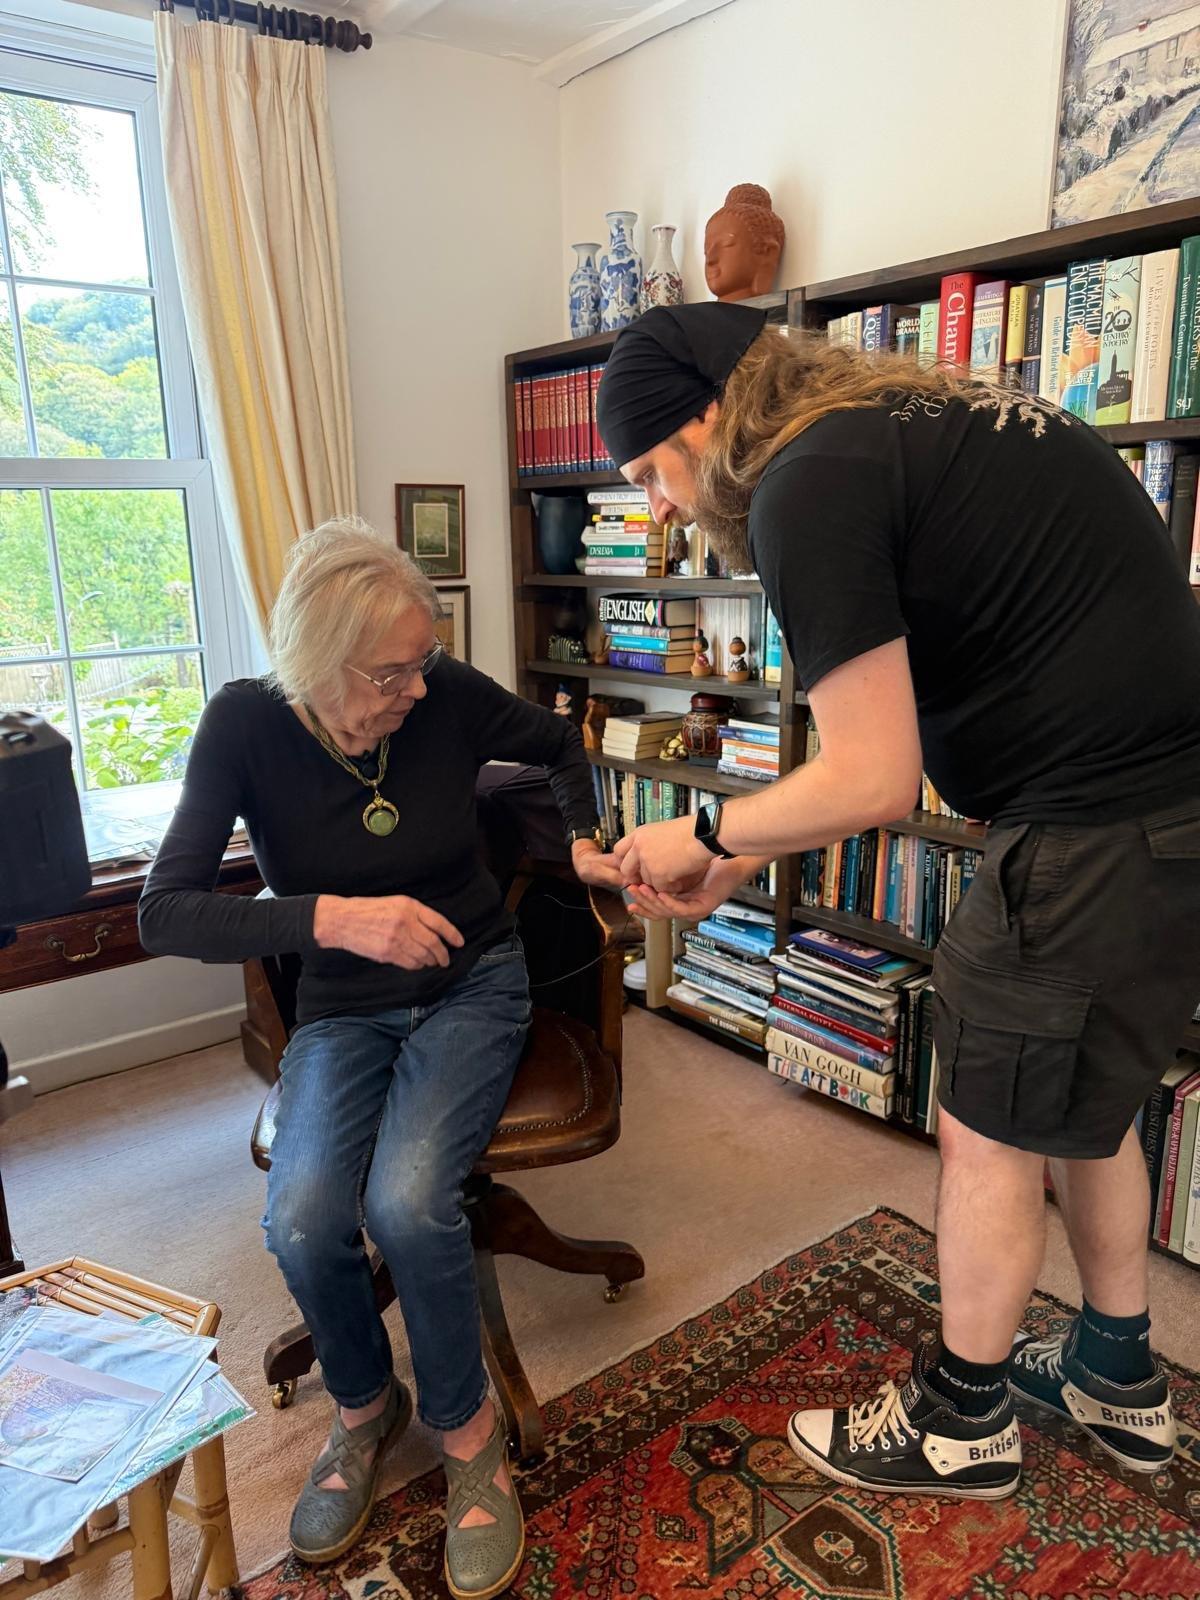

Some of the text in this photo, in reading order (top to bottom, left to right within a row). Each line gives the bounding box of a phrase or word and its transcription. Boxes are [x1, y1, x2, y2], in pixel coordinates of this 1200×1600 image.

[1154, 267, 1165, 300] LIVES
[1064, 264, 1089, 353] ENCYCLOPEDIA
[1083, 259, 1106, 348] THE MACMILLAN
[944, 291, 967, 369] Cham
[1149, 334, 1160, 370] POETS
[1190, 355, 1199, 371] the
[606, 600, 646, 622] ENGLISH
[778, 1001, 808, 1020] ETERNAL
[808, 1013, 832, 1028] EGYPT
[784, 1040, 861, 1086] VAN GOGH
[773, 1056, 798, 1079] THE
[829, 1077, 870, 1110] BOOK
[1145, 1086, 1164, 1152] TREASURES
[1166, 1116, 1181, 1182] PRE-RAPHAELITES
[938, 1366, 1007, 1392] DONNA
[1101, 1406, 1166, 1427] British
[968, 1430, 1019, 1460] British
